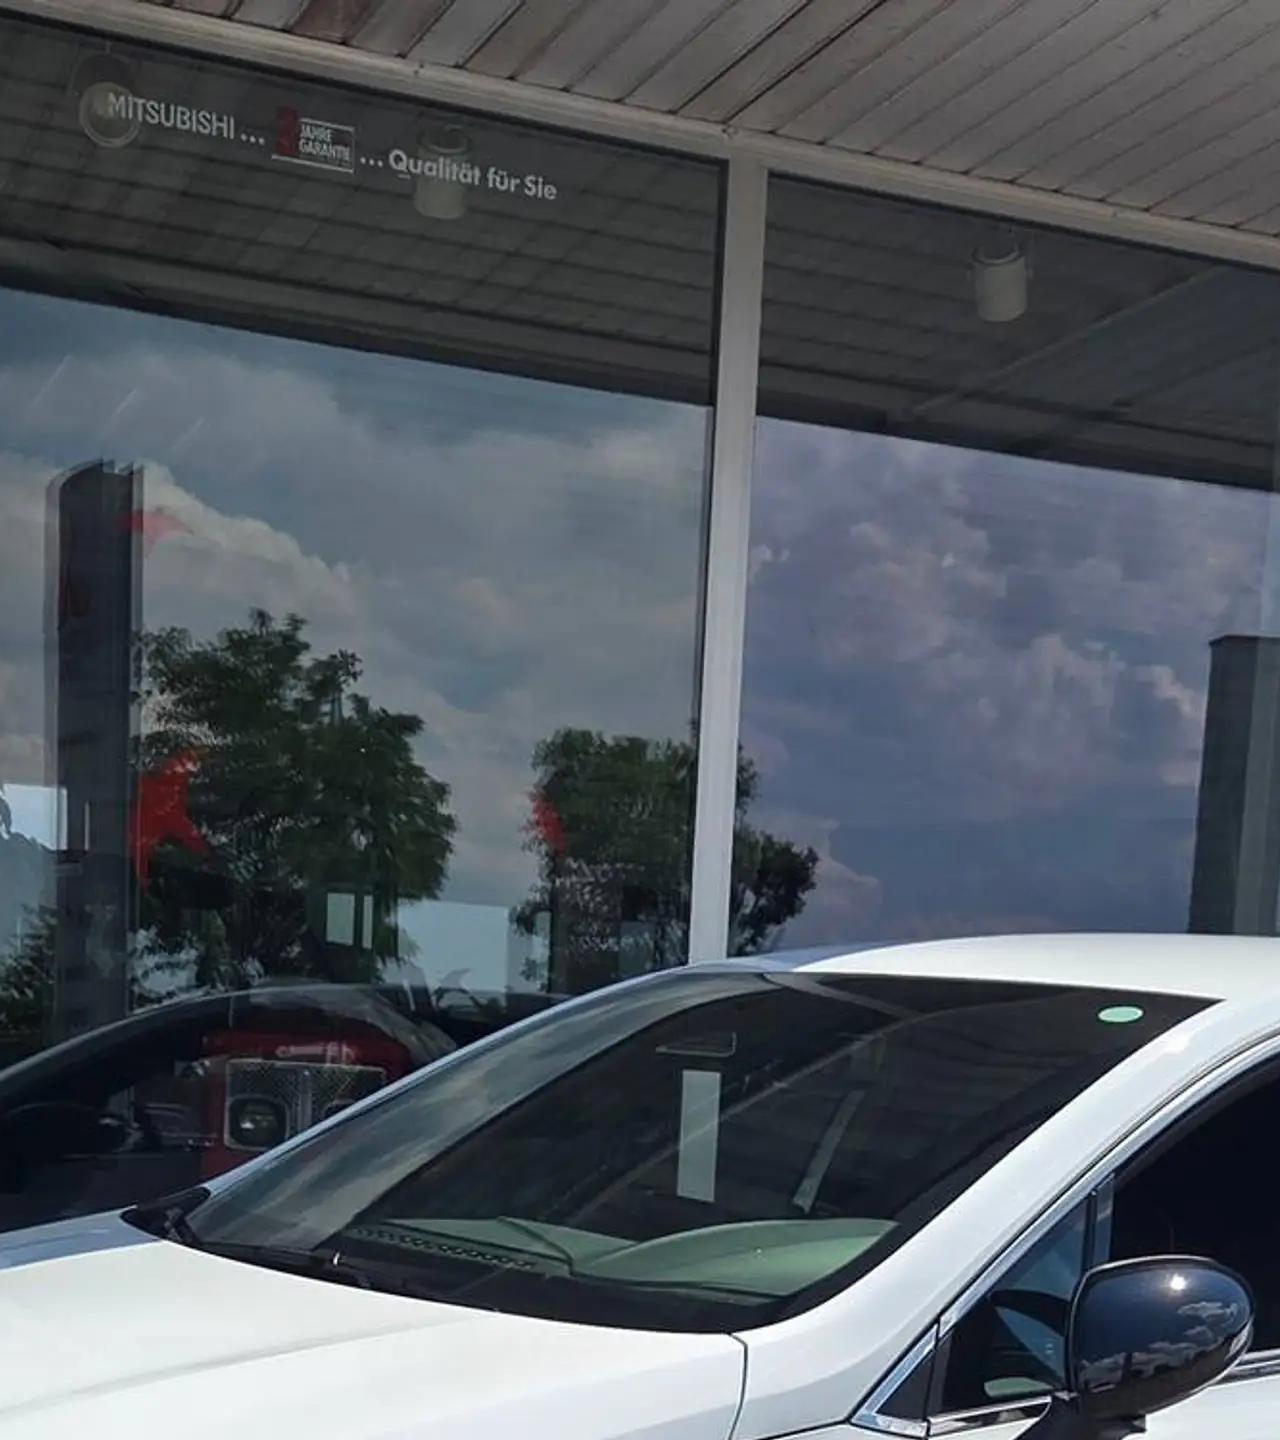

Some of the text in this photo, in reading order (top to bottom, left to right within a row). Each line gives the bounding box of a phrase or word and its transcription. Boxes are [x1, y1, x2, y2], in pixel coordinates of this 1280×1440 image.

[108, 92, 235, 139] MITSUBISHI
[389, 149, 480, 185] Qualität
[487, 166, 520, 192] für
[524, 174, 558, 200] Sie
